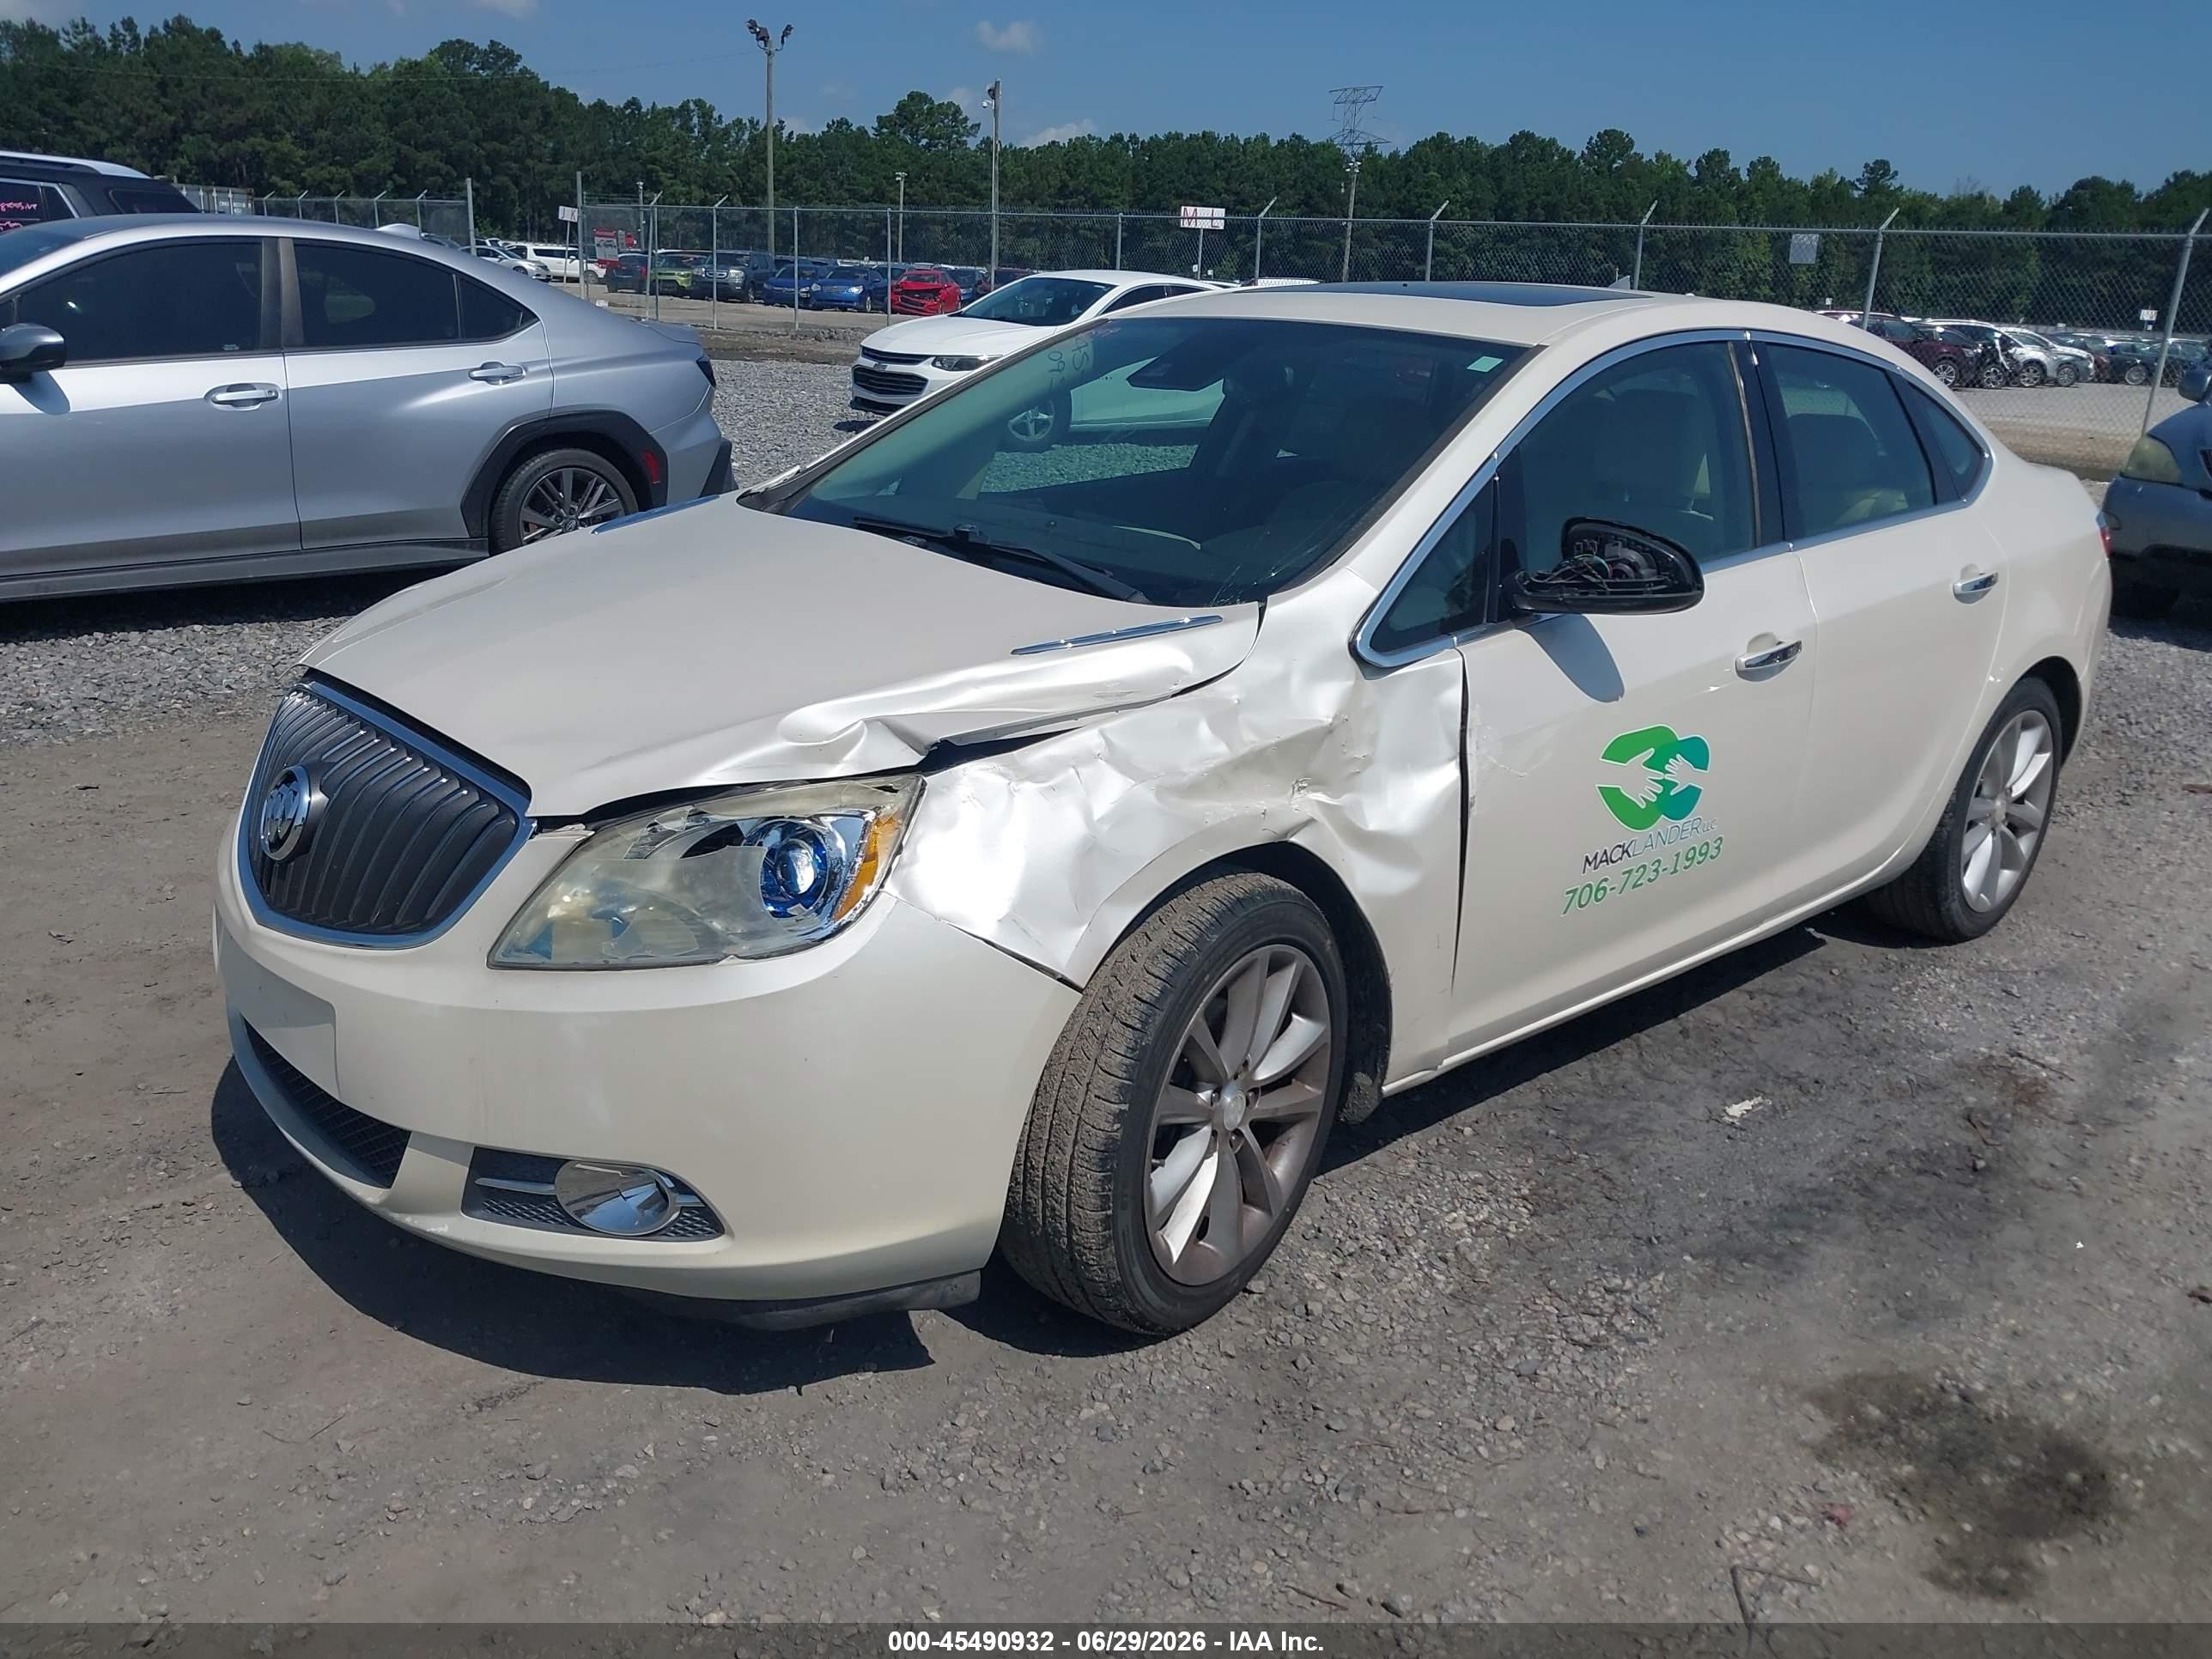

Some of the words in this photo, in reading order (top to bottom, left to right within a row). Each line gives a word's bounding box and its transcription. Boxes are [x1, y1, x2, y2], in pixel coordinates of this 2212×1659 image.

[1182, 207, 1199, 226] M
[1210, 209, 1220, 228] L
[1581, 817, 1702, 875] MACKLANDER
[1562, 836, 1723, 916] 706-723-1993
